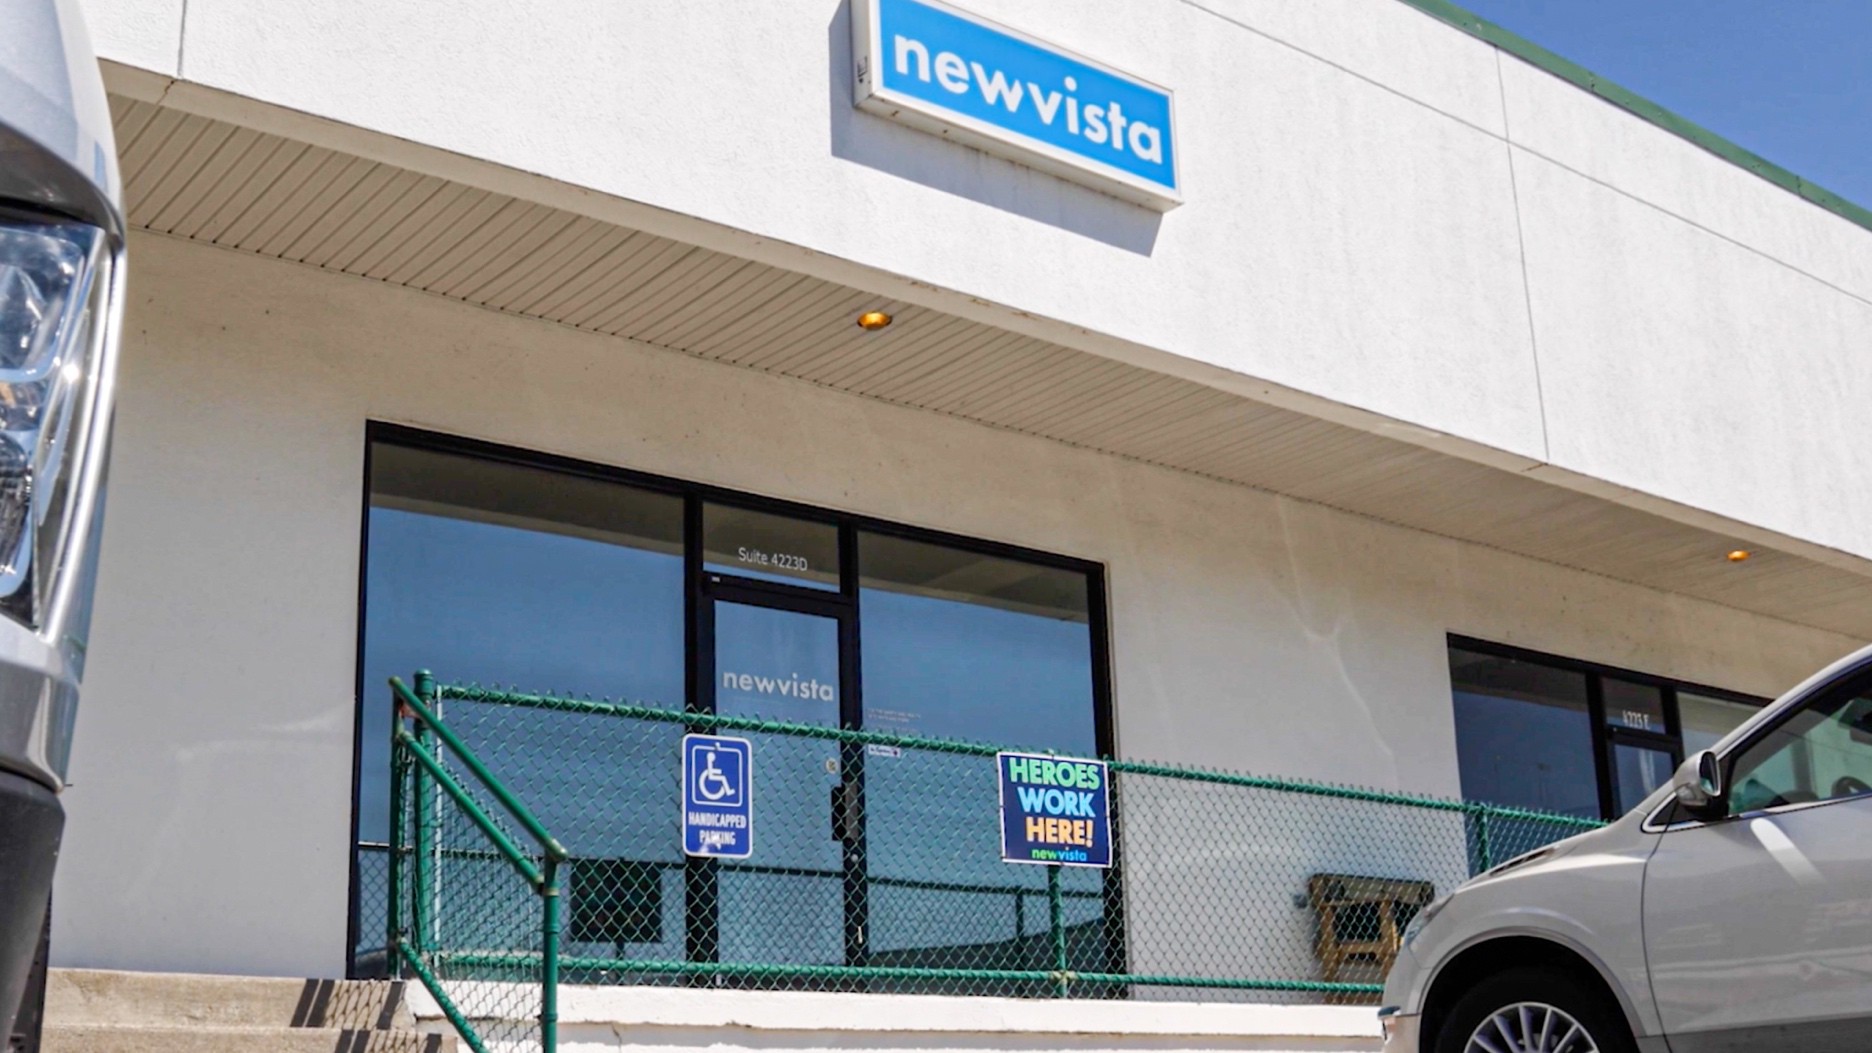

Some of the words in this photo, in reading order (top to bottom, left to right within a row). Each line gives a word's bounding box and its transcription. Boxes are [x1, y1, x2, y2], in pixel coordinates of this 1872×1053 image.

[894, 34, 1163, 165] newvista
[738, 547, 769, 566] Suite
[771, 553, 808, 572] 4223D
[722, 672, 834, 701] newvista
[1008, 757, 1101, 790] HEROES
[1017, 787, 1096, 818] WORK
[688, 811, 747, 829] HANDICAPPED
[1026, 816, 1094, 848] HERE!
[1031, 847, 1088, 862] newvista
